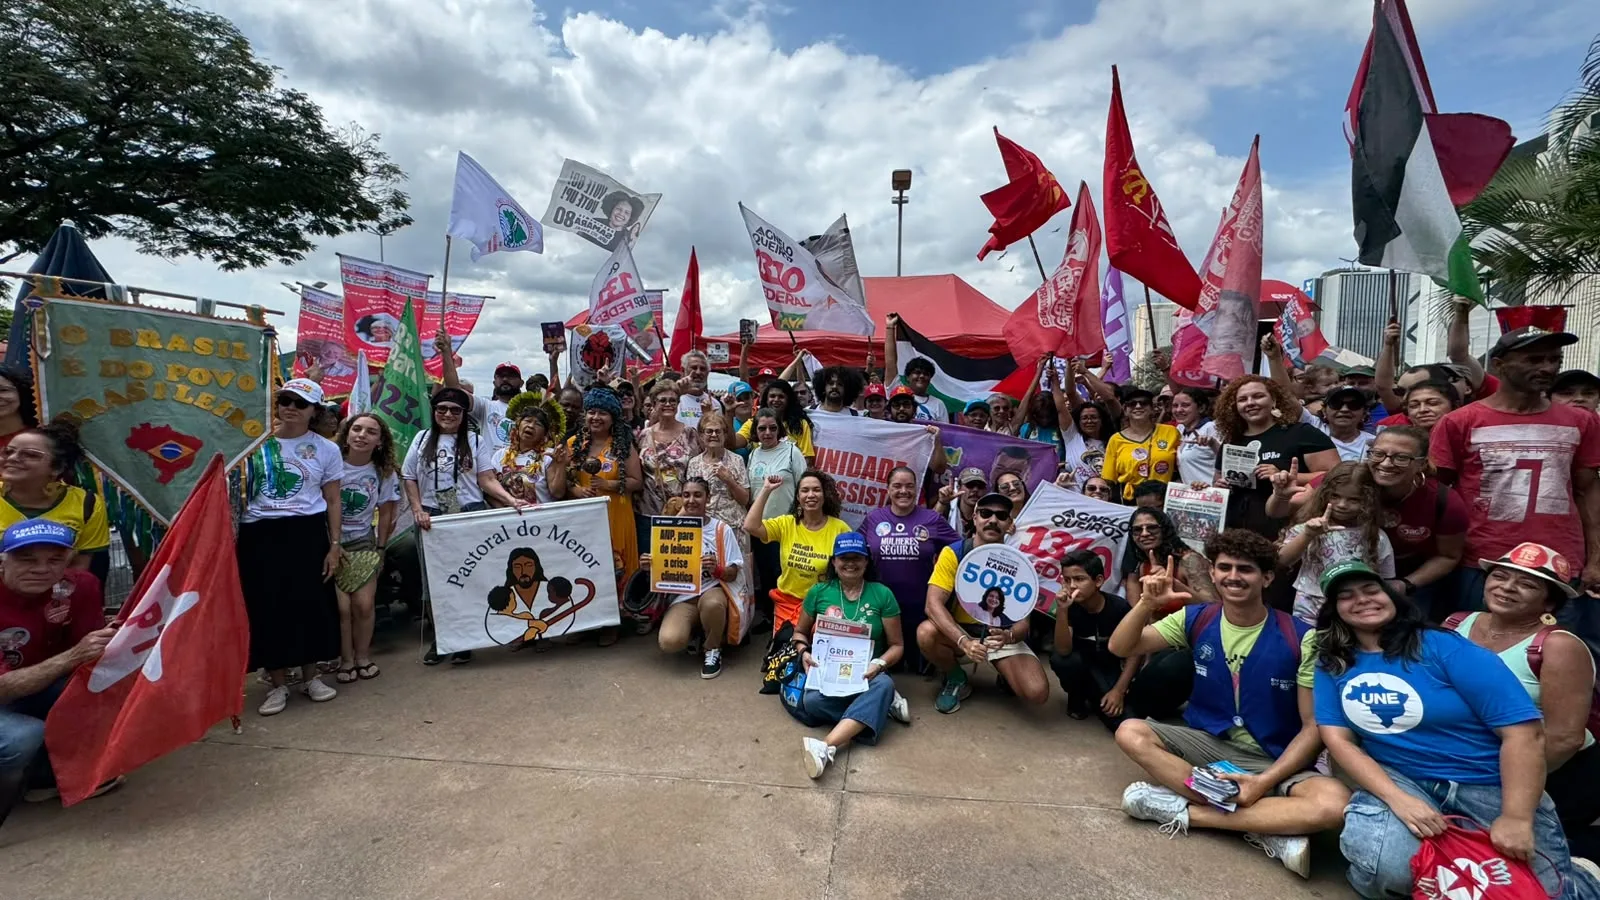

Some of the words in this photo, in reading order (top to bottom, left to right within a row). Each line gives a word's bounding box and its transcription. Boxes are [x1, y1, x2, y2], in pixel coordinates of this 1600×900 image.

[59, 324, 87, 345] O
[110, 328, 249, 361] BRASIL
[99, 358, 153, 379] DO
[166, 363, 256, 392] POVO
[836, 480, 889, 509] SSIST
[1062, 509, 1130, 532] AGNELO
[1051, 515, 1124, 544] QUEIROZ
[660, 530, 676, 541] ANP,
[678, 531, 694, 542] pare
[881, 537, 919, 546] MULHERES
[447, 525, 511, 589] Pastoral
[517, 520, 541, 537] do
[547, 524, 600, 569] Menor
[660, 544, 669, 554] de
[670, 543, 693, 555] leiloar
[880, 545, 920, 556] SEGURAS
[664, 558, 669, 568] a
[670, 557, 688, 568] crise
[985, 561, 1017, 577] KARINE
[661, 570, 693, 582] climática
[963, 562, 1033, 603] 5080
[824, 623, 850, 632] VERDADE
[830, 648, 854, 656] GRITO
[1361, 692, 1400, 704] UNE
